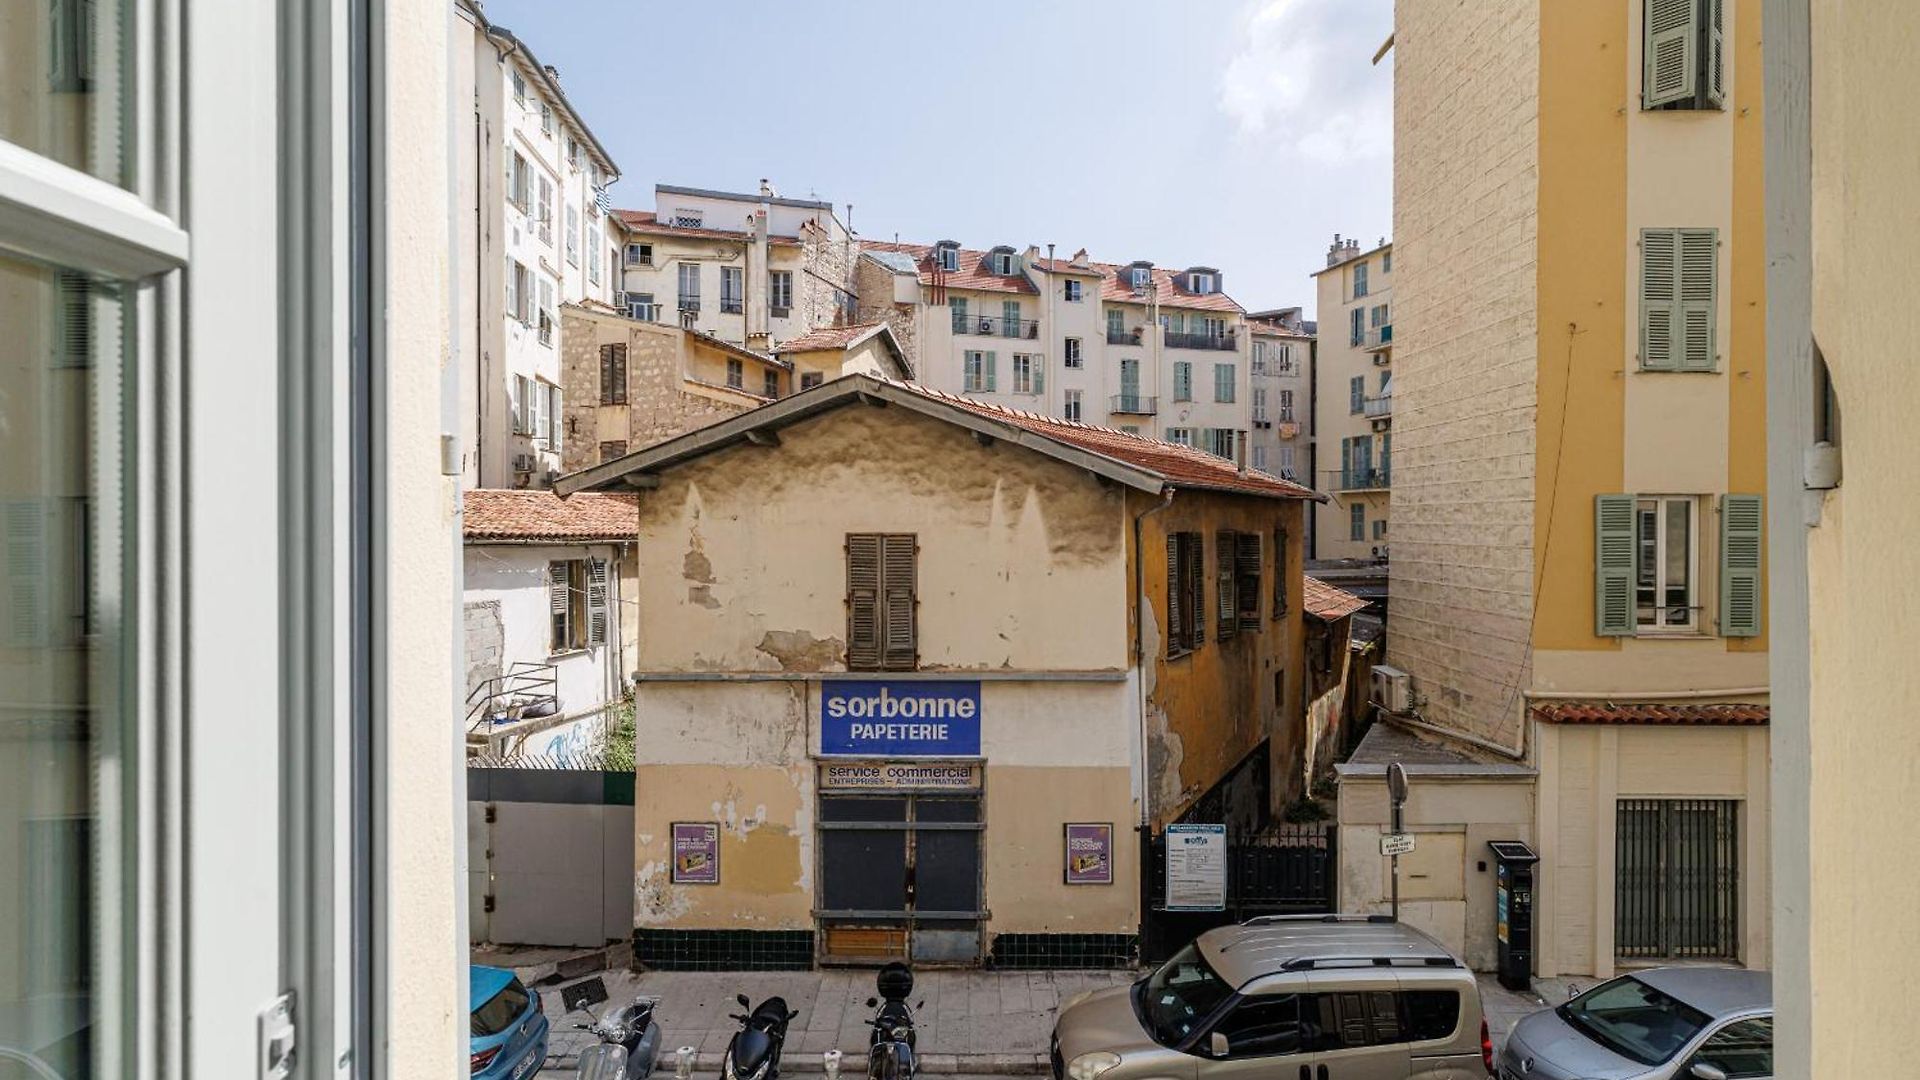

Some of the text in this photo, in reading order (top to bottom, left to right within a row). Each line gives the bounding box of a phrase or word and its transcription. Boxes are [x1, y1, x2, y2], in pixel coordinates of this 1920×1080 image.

[828, 687, 975, 718] sorbonne
[851, 723, 948, 740] PAPETERIE
[829, 766, 972, 778] service commercial
